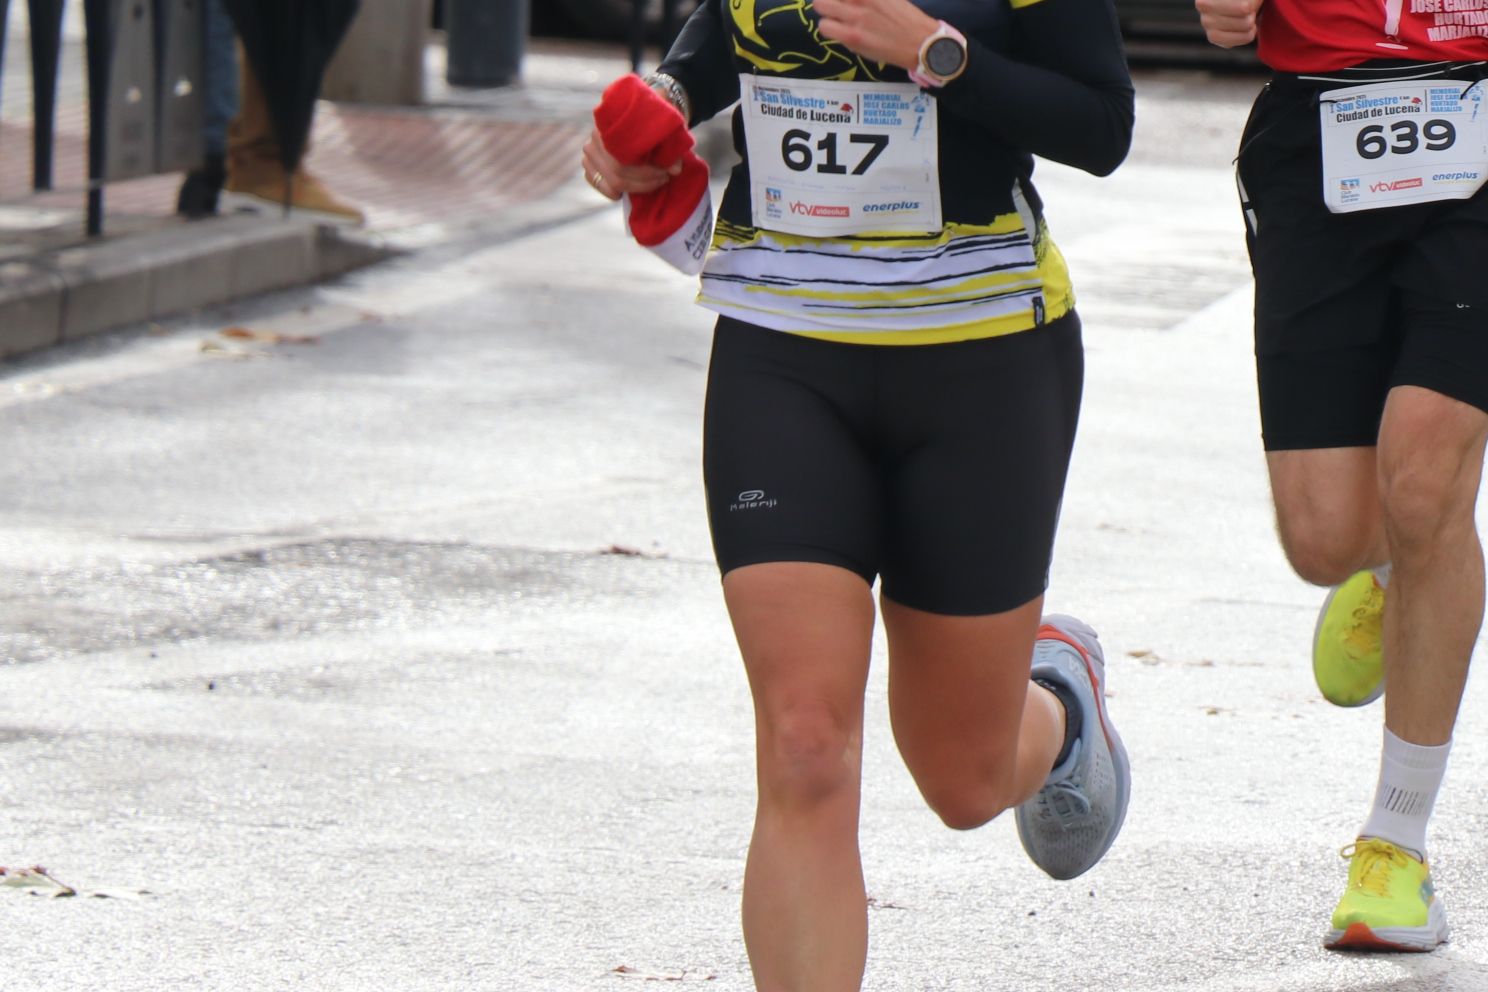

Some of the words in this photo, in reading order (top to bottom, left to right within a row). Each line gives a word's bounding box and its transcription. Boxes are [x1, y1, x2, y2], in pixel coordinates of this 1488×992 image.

[760, 90, 779, 104] San
[780, 92, 825, 108] Silvestre
[1336, 102, 1354, 113] San
[1355, 96, 1398, 110] Silvestre
[761, 103, 794, 119] Ciudad
[796, 109, 808, 120] de
[810, 110, 851, 123] Lucena
[1336, 109, 1369, 123] Ciudad
[1371, 107, 1383, 118] de
[1385, 104, 1420, 115] Lucena
[1356, 119, 1457, 160] 639
[781, 128, 890, 175] 617
[1432, 172, 1479, 182] enerplus
[863, 200, 920, 213] enerplus
